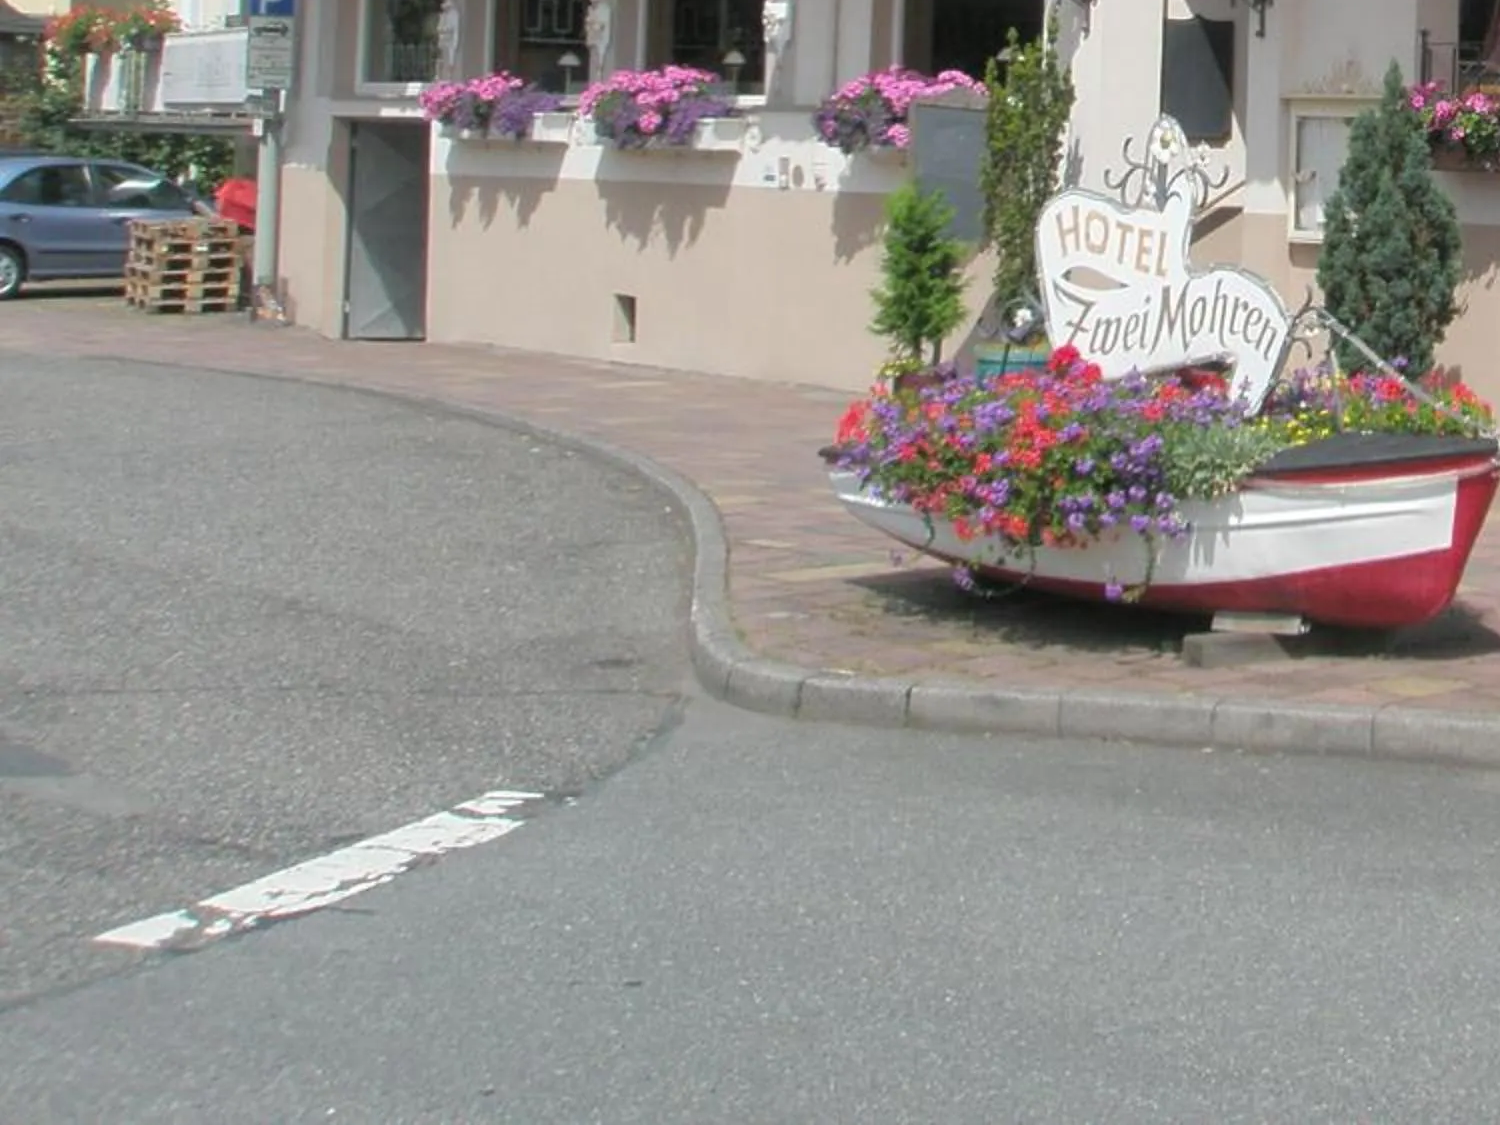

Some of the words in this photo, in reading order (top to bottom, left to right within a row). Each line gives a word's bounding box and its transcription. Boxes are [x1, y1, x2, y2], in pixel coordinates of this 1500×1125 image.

[1055, 204, 1170, 279] HOTEL
[1052, 276, 1152, 355] Zwei
[1148, 277, 1279, 361] Mohren
